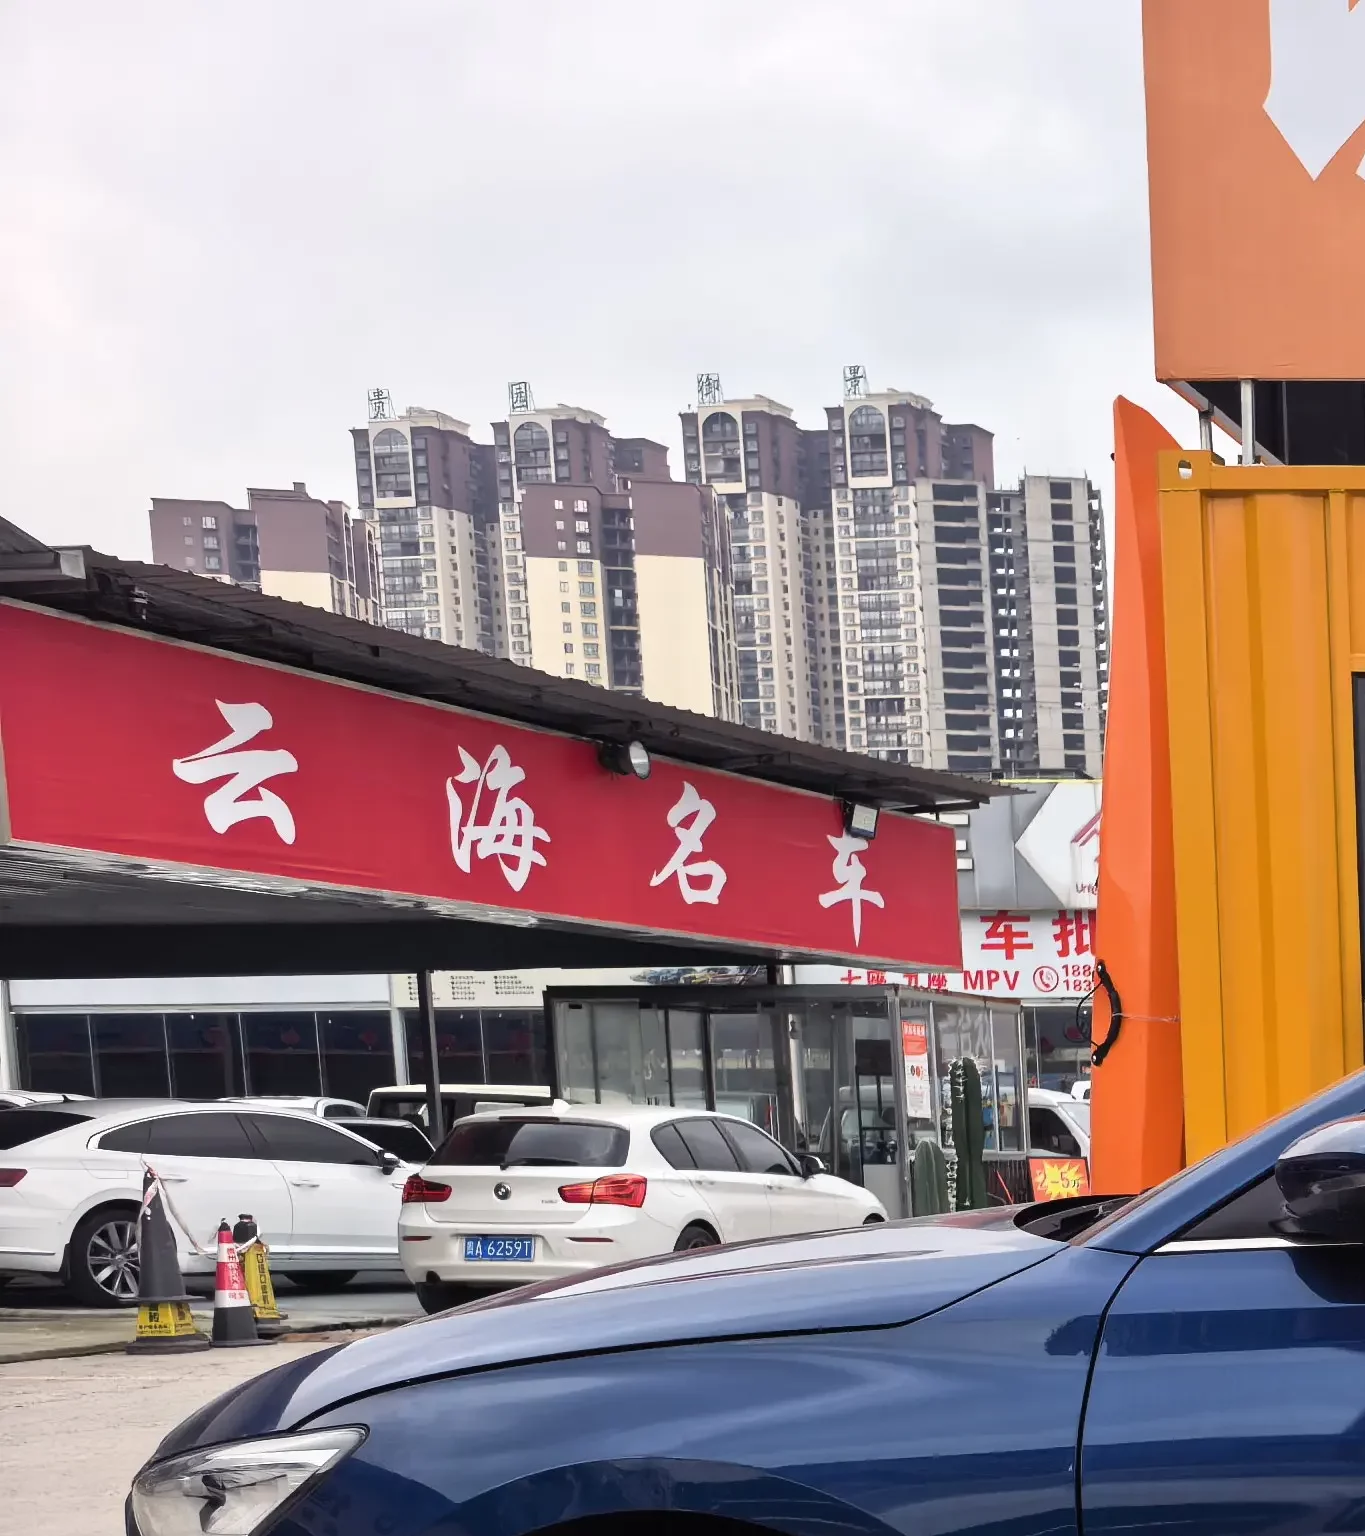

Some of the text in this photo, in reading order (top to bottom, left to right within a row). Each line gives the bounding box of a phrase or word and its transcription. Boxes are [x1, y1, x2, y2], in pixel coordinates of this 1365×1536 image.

[172, 698, 885, 949] 云海名车
[963, 970, 1020, 991] MPV
